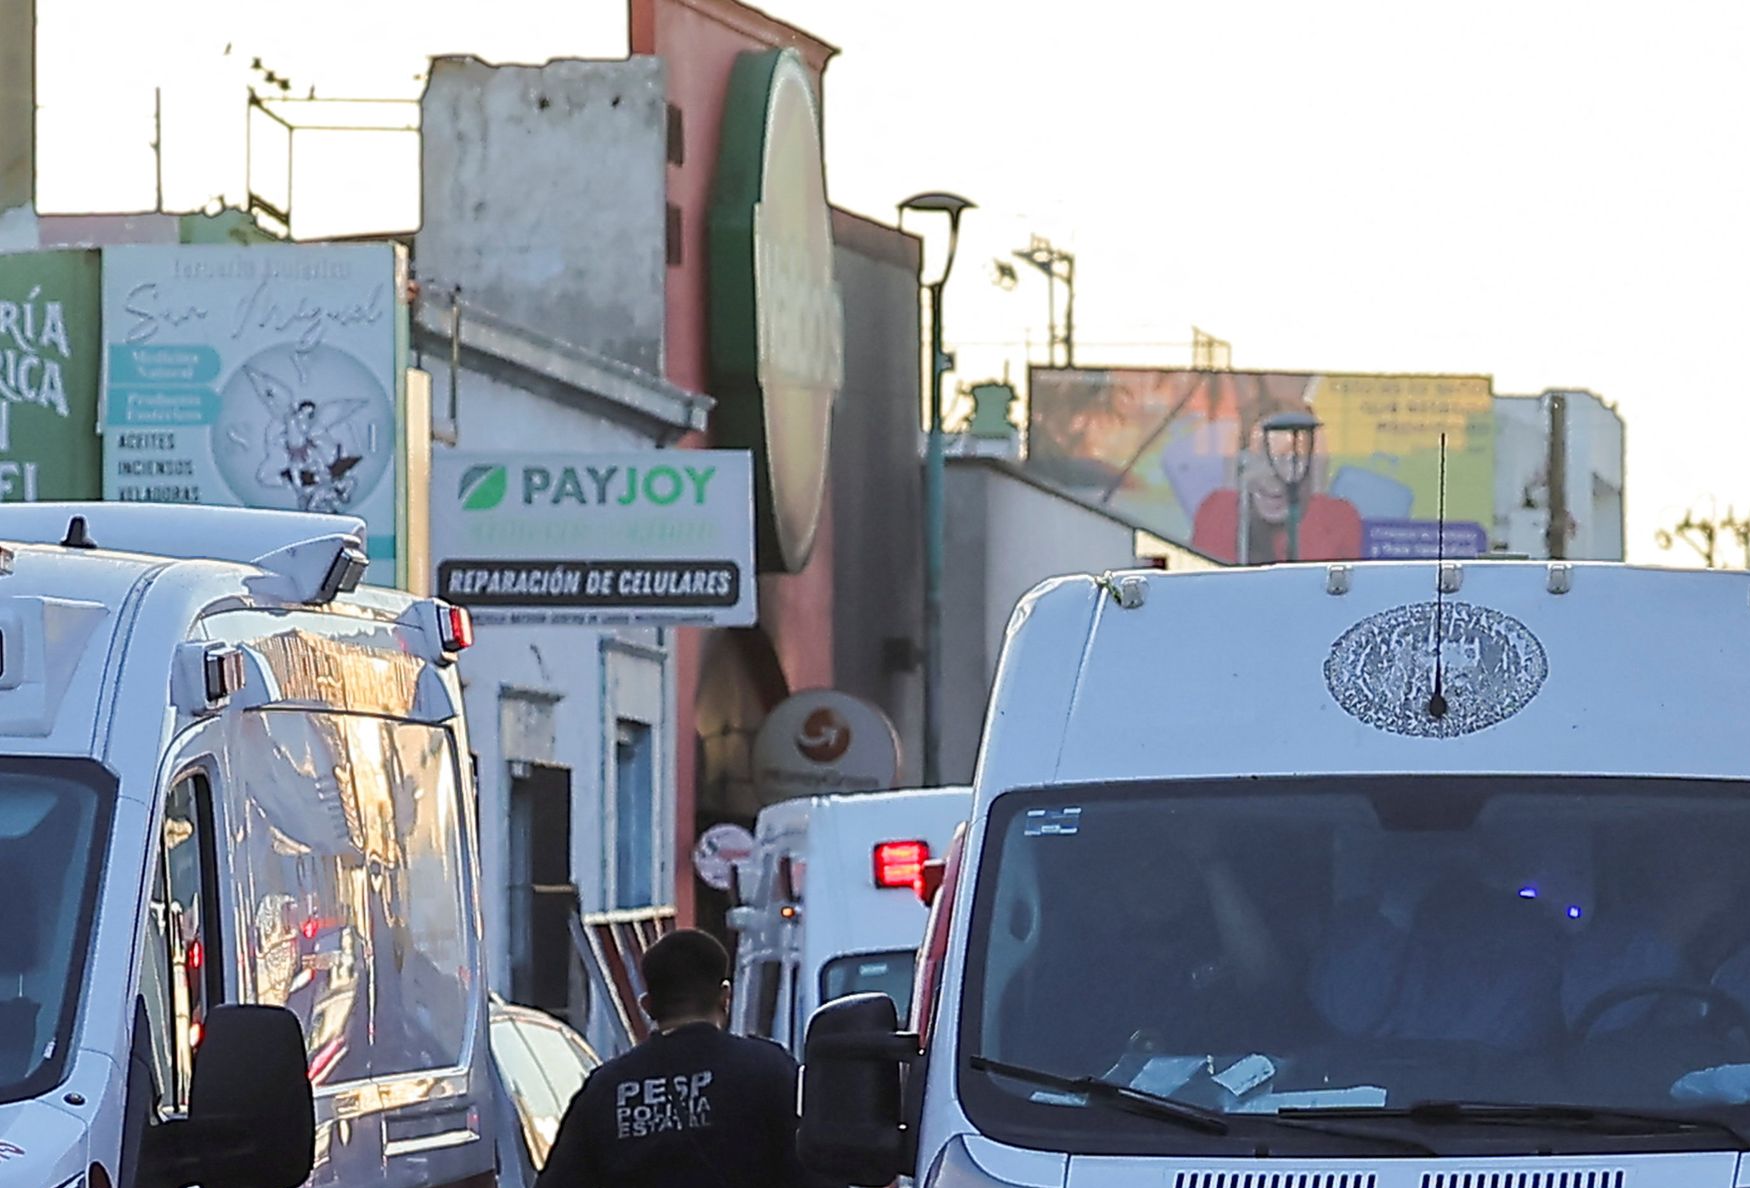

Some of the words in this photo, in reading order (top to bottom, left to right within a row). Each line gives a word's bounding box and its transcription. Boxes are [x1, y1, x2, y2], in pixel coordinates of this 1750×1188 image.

[117, 432, 175, 450] ACEITES
[117, 460, 194, 476] INCIENSOS
[522, 465, 717, 505] PAYJOY
[448, 565, 580, 596] REPARACIÓN
[585, 569, 614, 596] DE
[617, 568, 731, 596] CELULARES
[616, 1096, 711, 1122] POLIIA
